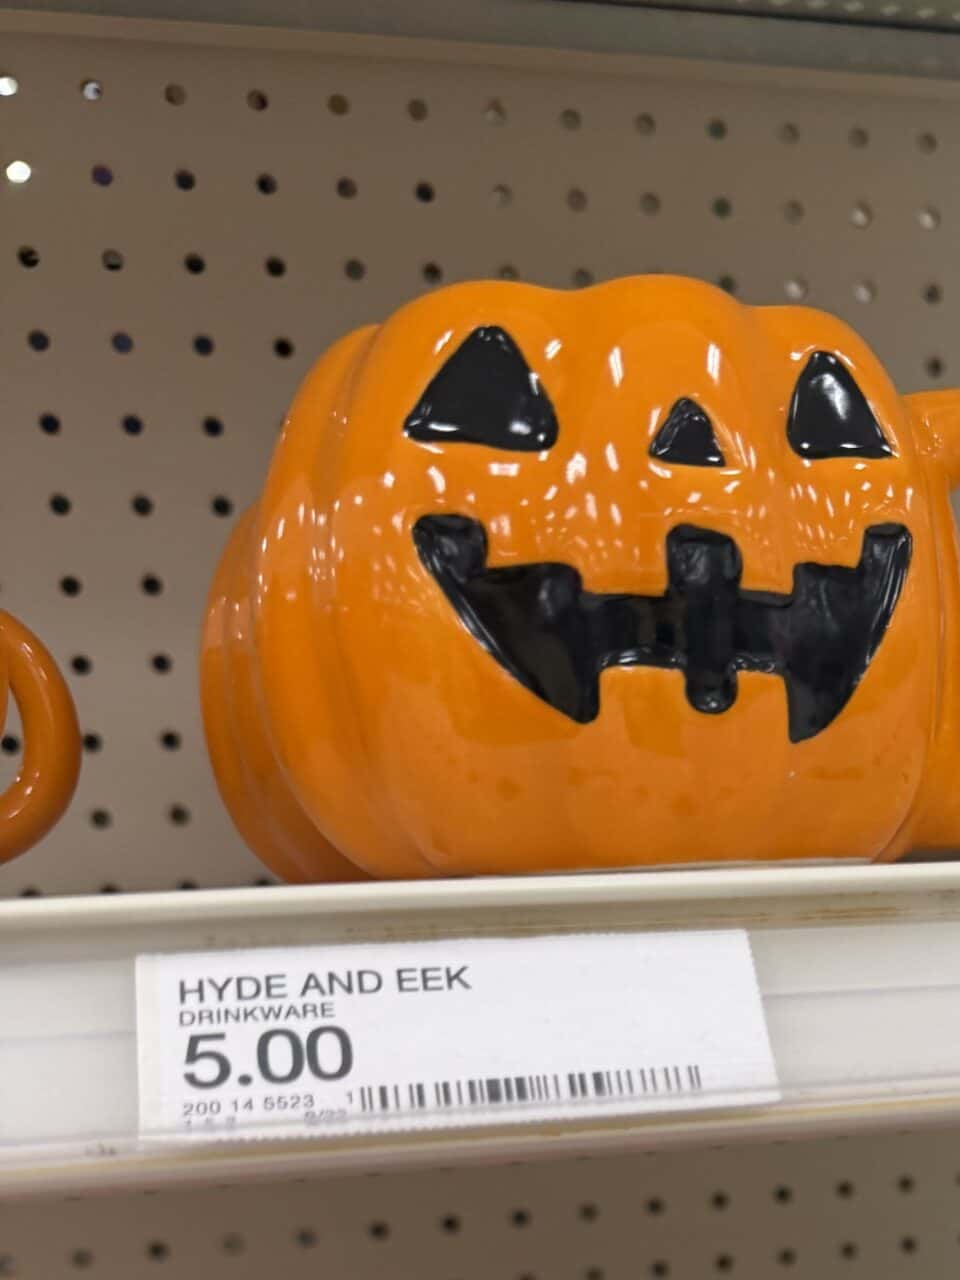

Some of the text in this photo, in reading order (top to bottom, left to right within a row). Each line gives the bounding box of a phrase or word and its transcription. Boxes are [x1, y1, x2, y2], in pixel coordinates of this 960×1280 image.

[178, 966, 472, 1005] HYDE AND EEK
[179, 1002, 337, 1027] DRINKWARE
[183, 1025, 353, 1090] 5.00
[183, 1101, 222, 1117] 200
[233, 1097, 254, 1113] 14
